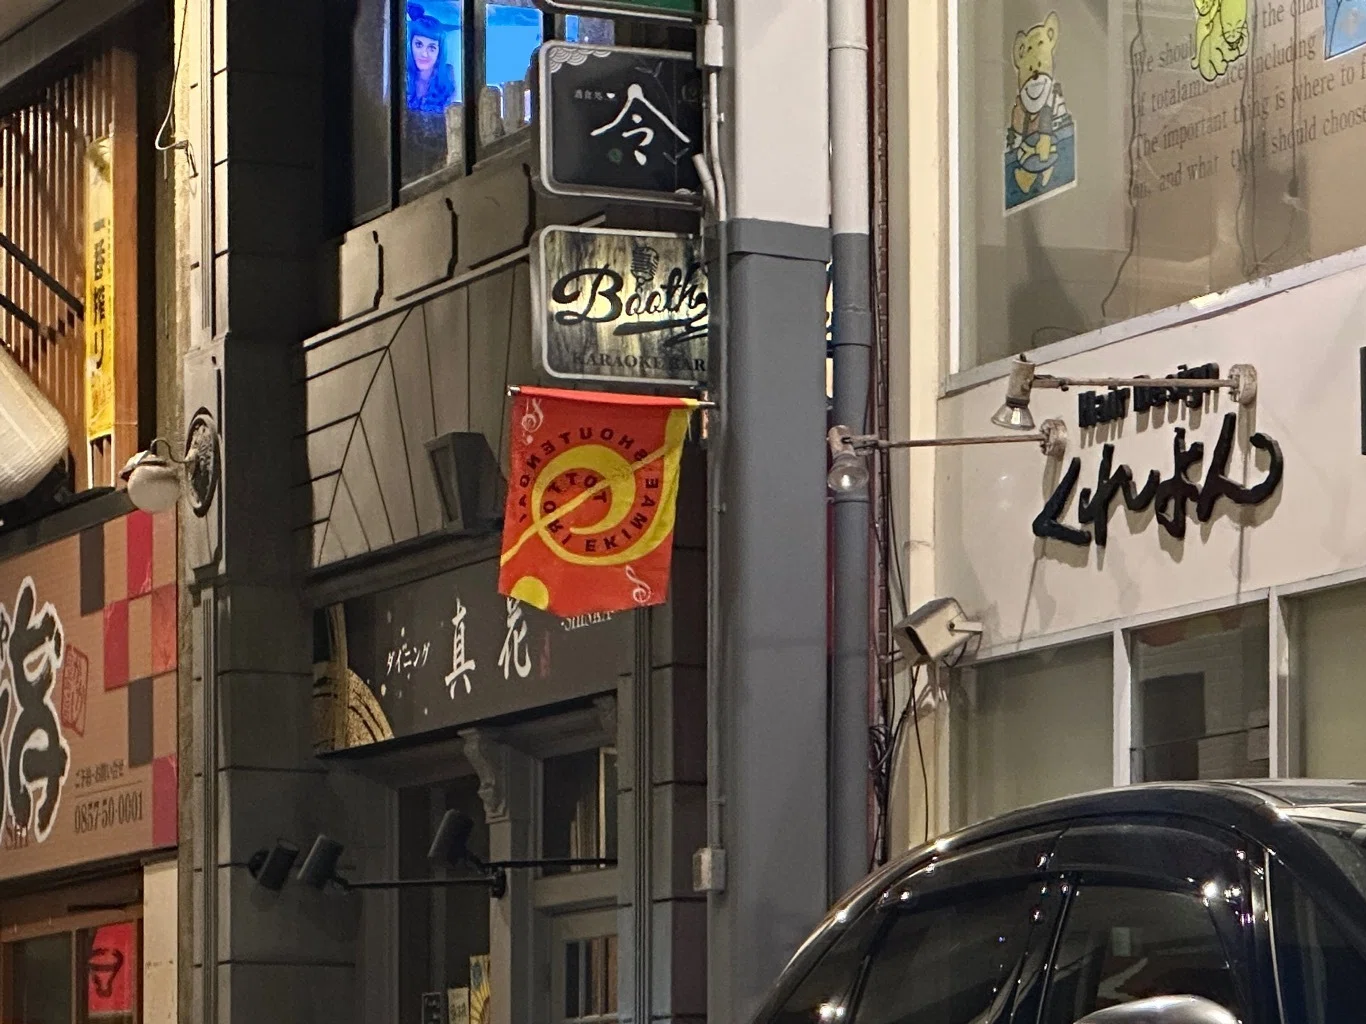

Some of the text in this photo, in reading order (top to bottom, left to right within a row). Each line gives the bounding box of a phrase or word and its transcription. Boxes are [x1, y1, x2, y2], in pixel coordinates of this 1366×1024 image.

[1263, 2, 1285, 28] the
[1160, 34, 1193, 68] shoul
[1163, 110, 1228, 150] important
[1275, 85, 1286, 111] is
[1340, 63, 1355, 87] to
[1271, 115, 1317, 154] should
